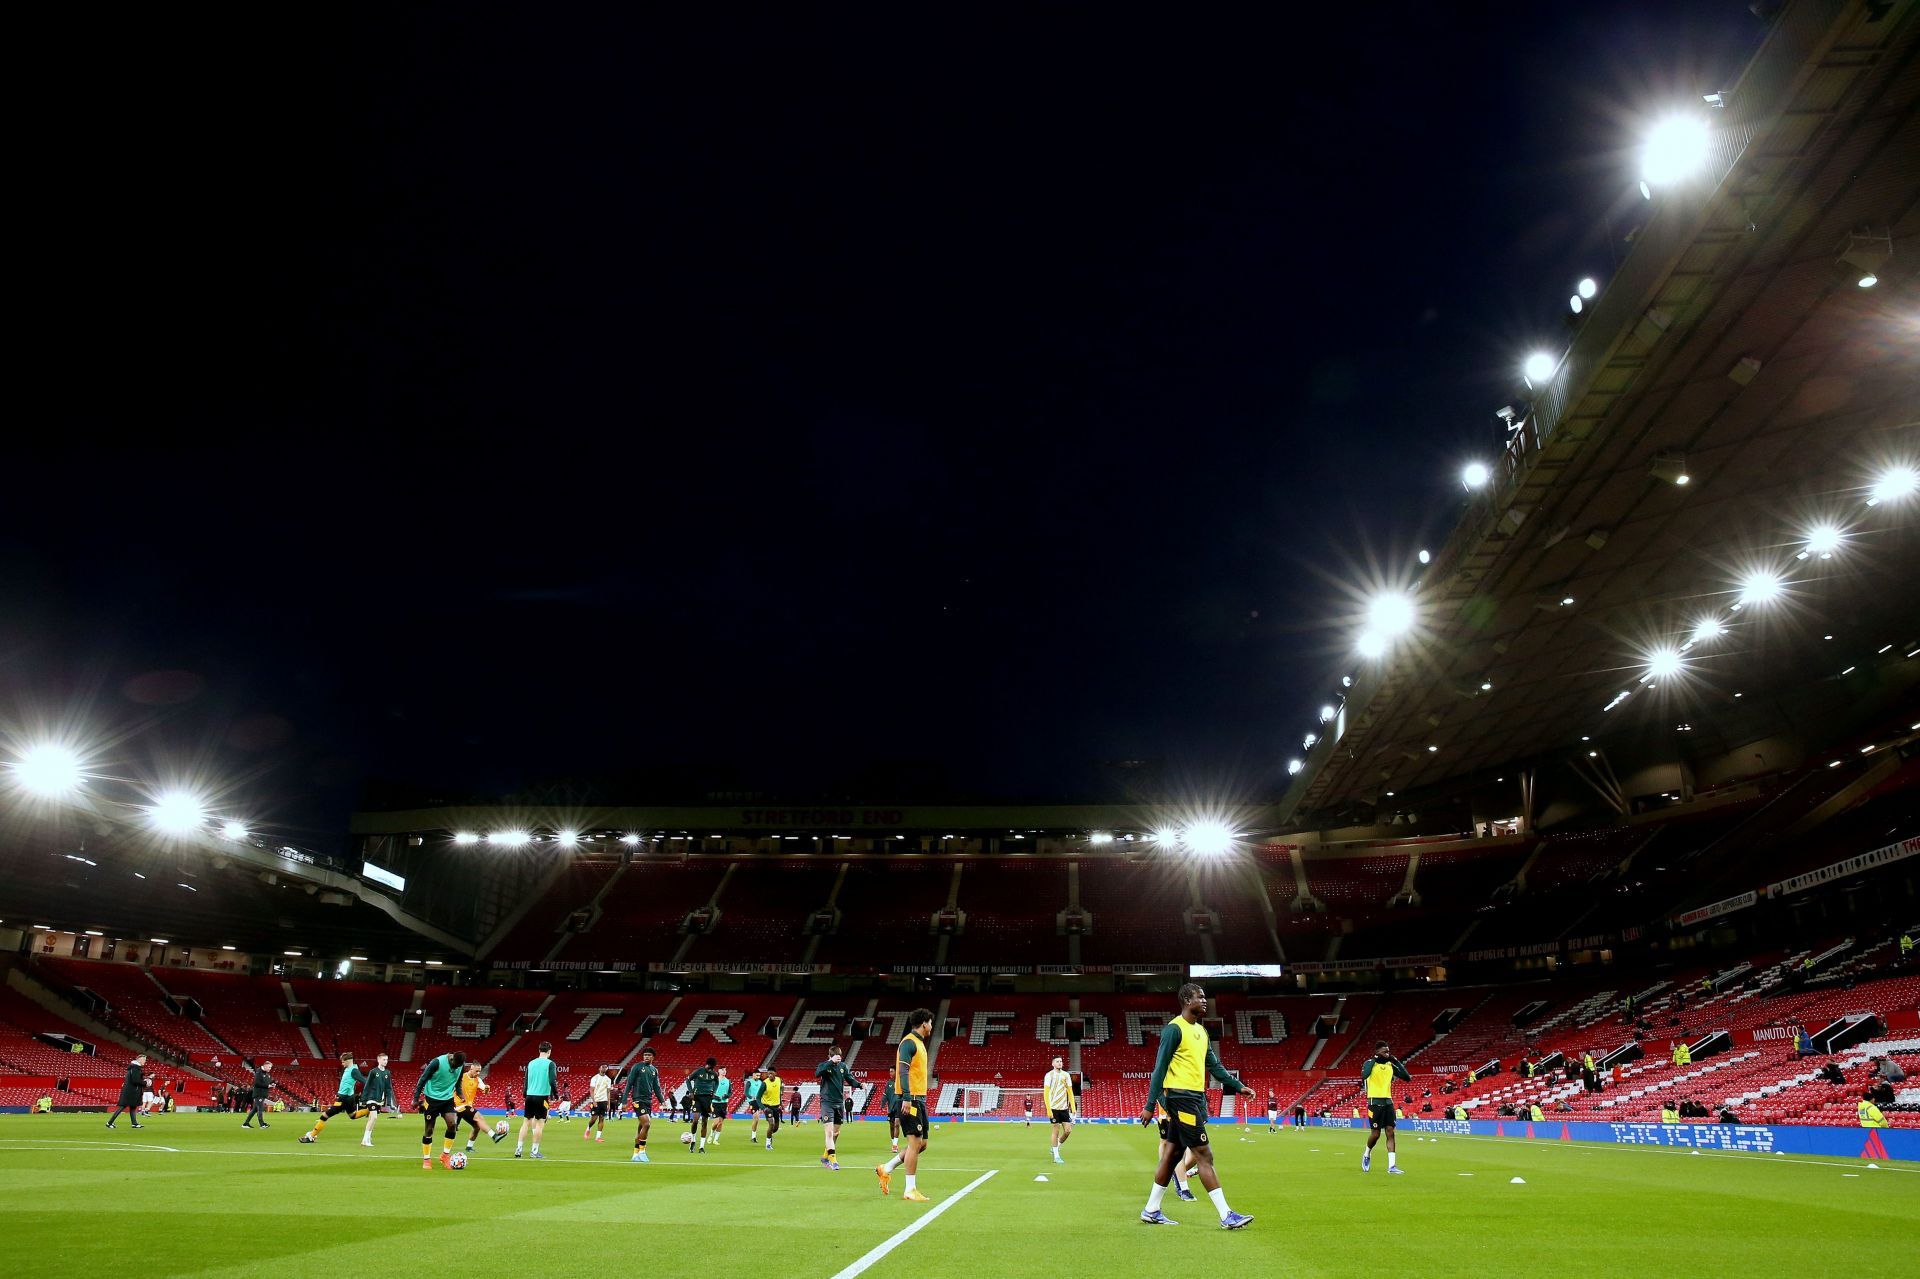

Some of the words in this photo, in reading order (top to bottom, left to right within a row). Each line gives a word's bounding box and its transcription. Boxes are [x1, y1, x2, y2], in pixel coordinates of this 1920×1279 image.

[743, 809, 853, 824] STRETFORD
[864, 810, 902, 824] END
[1584, 935, 1604, 947] ARMY
[1507, 947, 1517, 958] OF
[1519, 941, 1560, 957] MANCUNIA
[511, 961, 531, 969] LOVE
[540, 961, 586, 970] STRETFORD
[613, 962, 636, 971] MUFC
[775, 964, 816, 972] RELIGION
[937, 965, 949, 973] THE
[951, 965, 980, 974] FLOWERS
[981, 965, 989, 973] OF
[991, 965, 1033, 974] MANCHESTER
[1753, 1026, 1804, 1042] MANUTD.CO
[1433, 1064, 1469, 1074] MANUTD.COM
